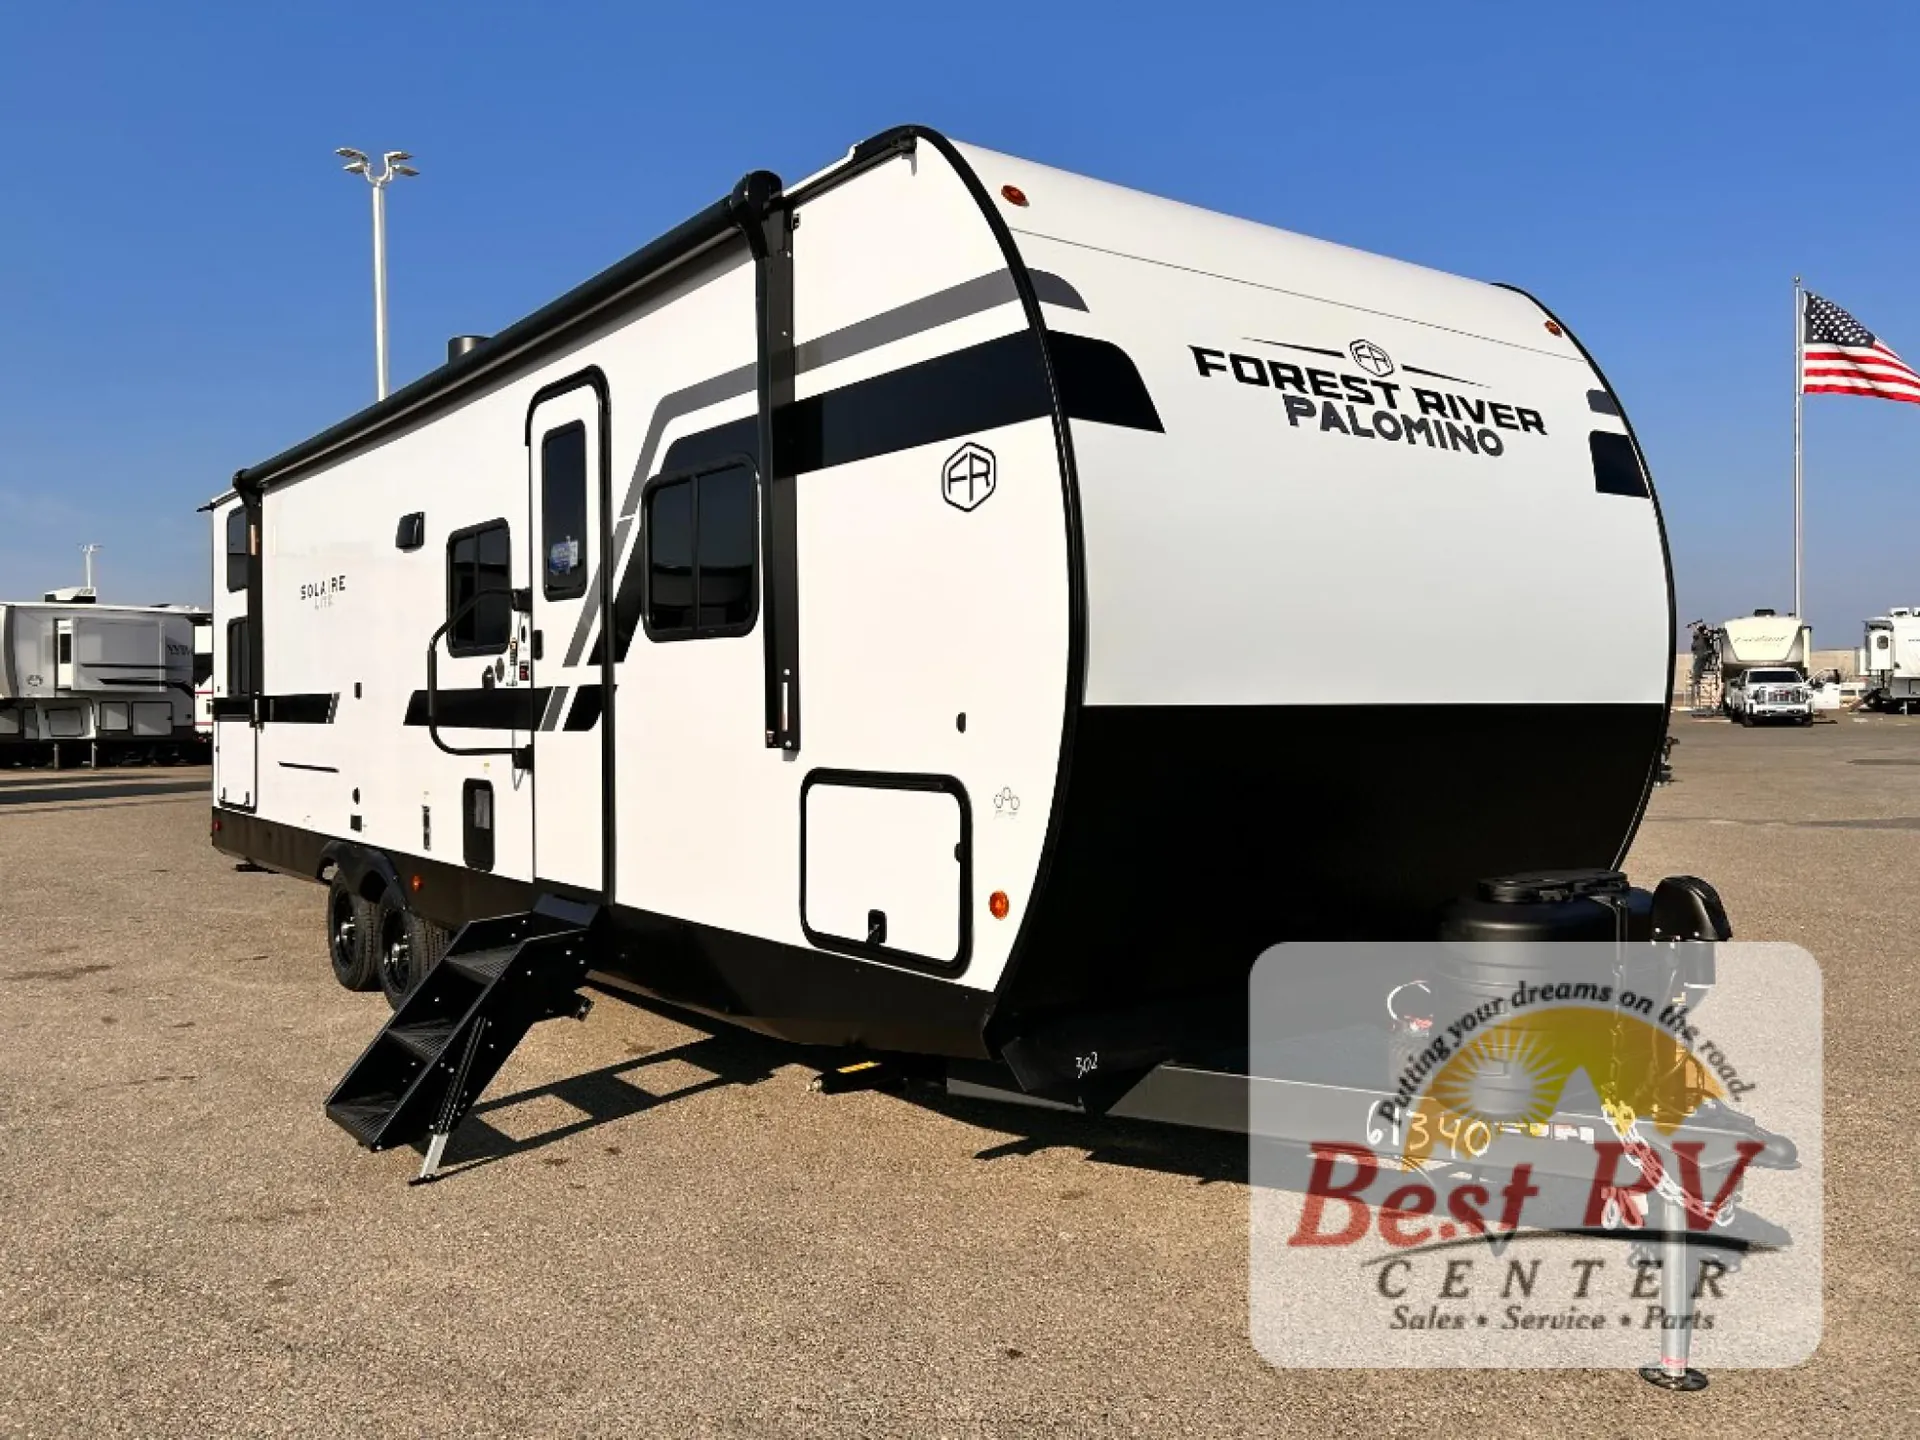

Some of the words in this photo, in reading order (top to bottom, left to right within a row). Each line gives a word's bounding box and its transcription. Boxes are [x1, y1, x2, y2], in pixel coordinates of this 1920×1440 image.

[1187, 345, 1400, 409] FOREST
[1410, 386, 1548, 436] RIVER
[1282, 394, 1504, 457] PALOMINO
